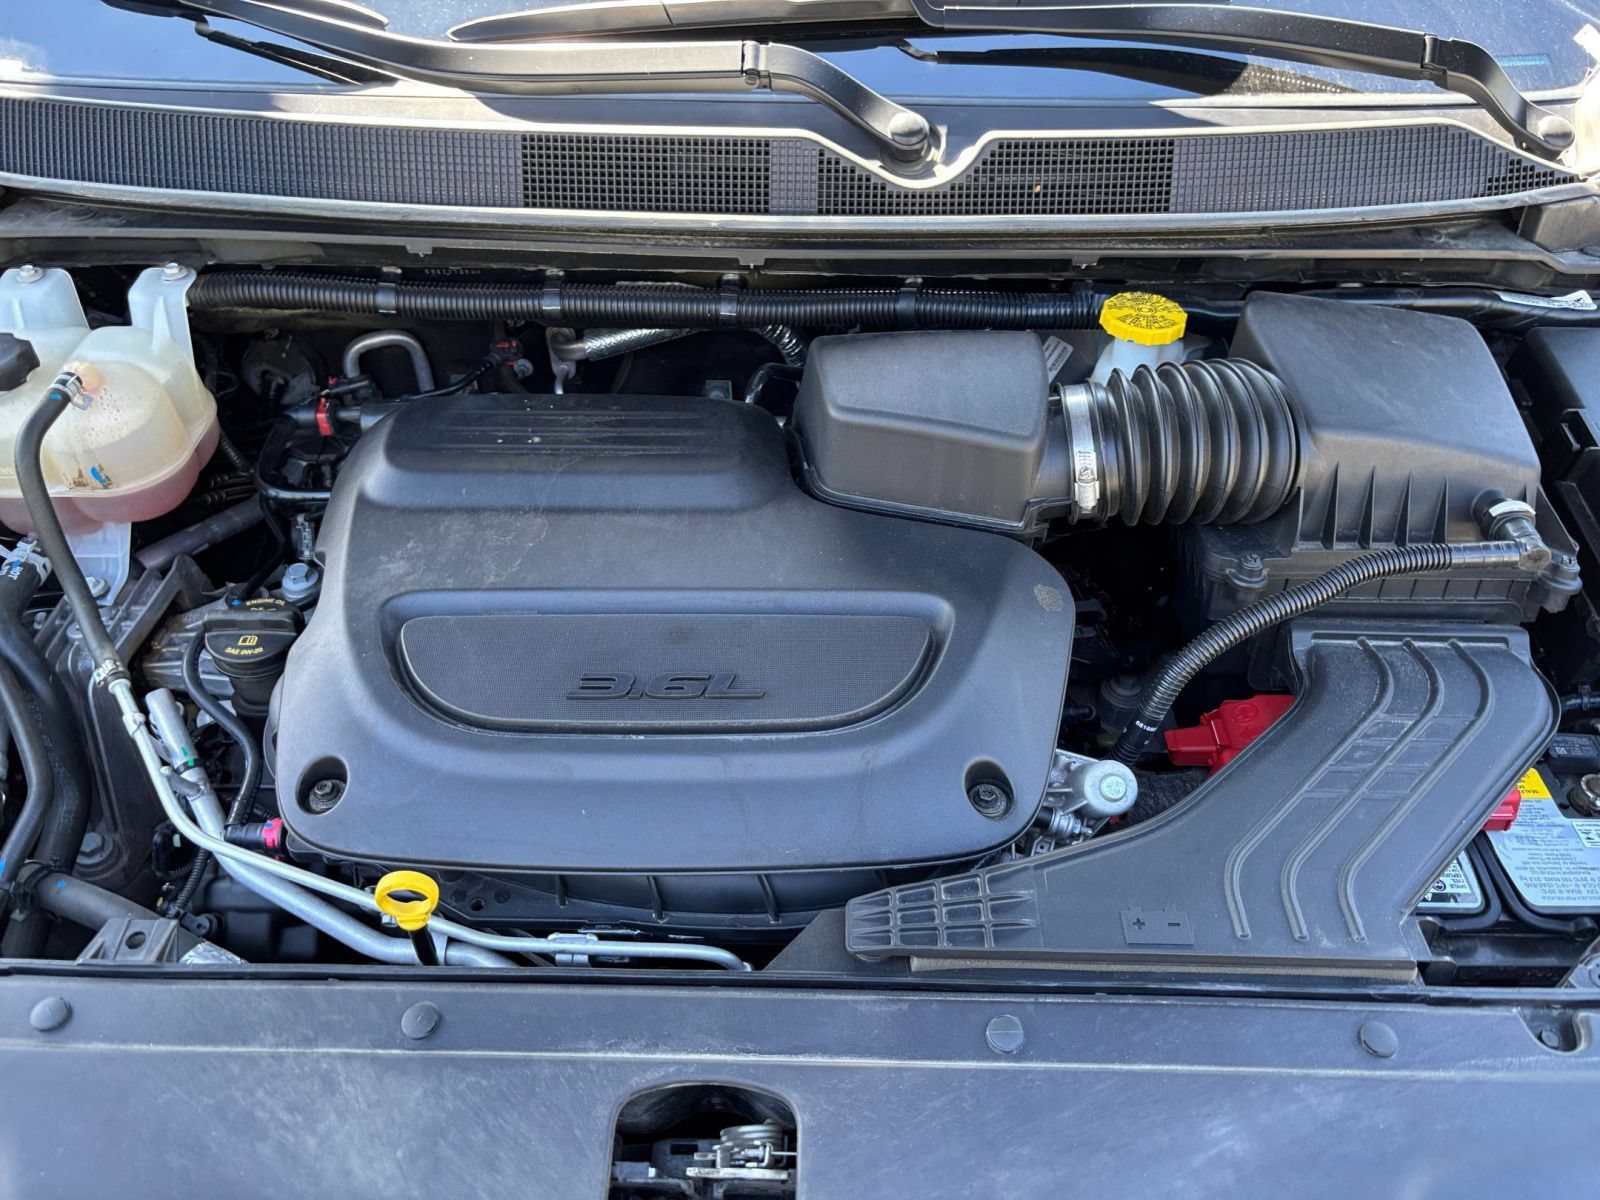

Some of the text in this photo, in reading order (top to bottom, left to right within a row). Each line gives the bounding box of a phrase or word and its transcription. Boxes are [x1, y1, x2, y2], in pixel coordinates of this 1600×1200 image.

[246, 598, 275, 606] ENGINE
[224, 647, 240, 655] SAE
[566, 671, 766, 700] 3.6L
